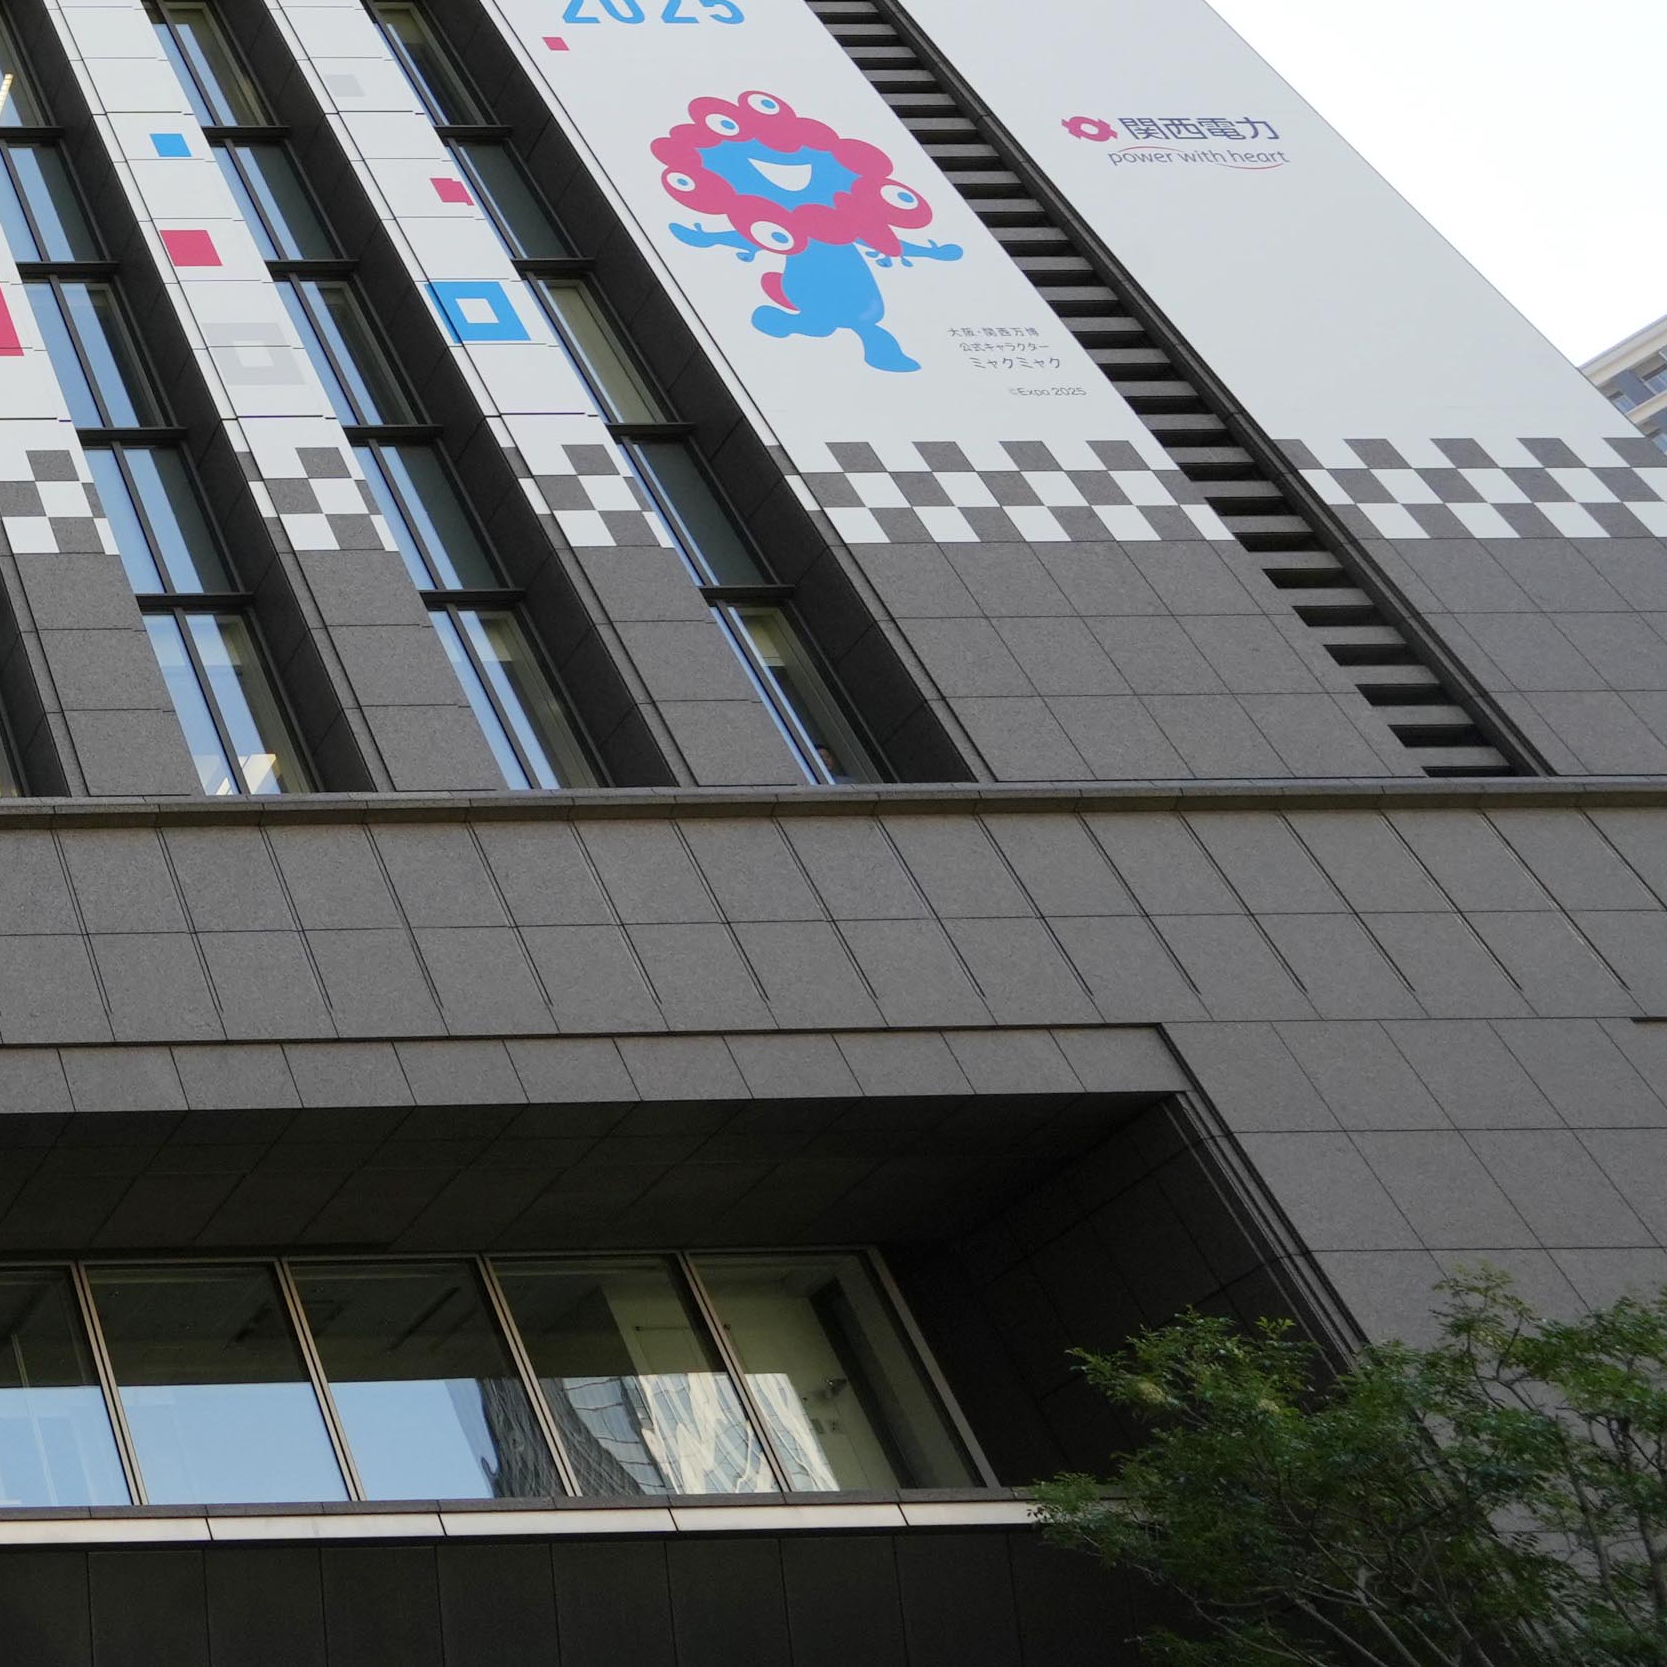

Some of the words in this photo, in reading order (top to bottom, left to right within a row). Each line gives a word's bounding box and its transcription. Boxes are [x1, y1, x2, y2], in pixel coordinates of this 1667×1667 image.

[1117, 117, 1280, 140] 関西電力
[1108, 150, 1174, 166] power
[1176, 150, 1227, 164] with
[1226, 150, 1290, 164] heart
[947, 327, 1040, 337] 大阪・関西万博
[959, 342, 1050, 352] 公式キャラクター
[968, 356, 1061, 369] ミャクミャク
[1051, 387, 1087, 396] 2025
